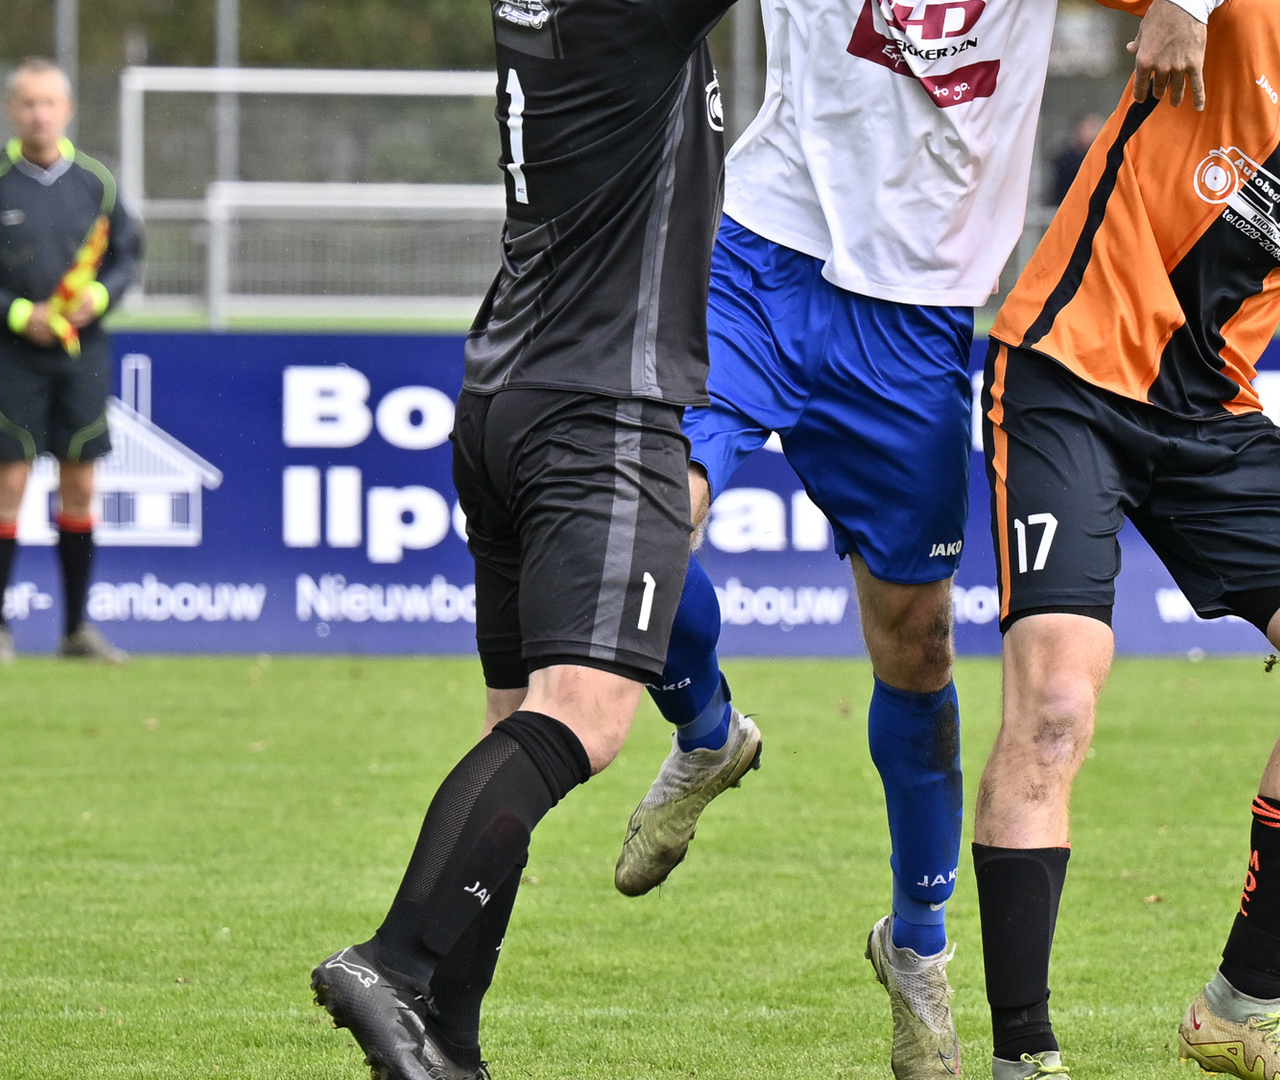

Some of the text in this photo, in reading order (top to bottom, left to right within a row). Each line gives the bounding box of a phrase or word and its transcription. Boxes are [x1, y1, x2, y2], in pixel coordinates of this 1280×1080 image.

[894, 38, 948, 61] EKKER
[933, 85, 950, 98] to
[1255, 74, 1279, 104] JAKO
[505, 68, 529, 205] 1
[929, 539, 963, 558] JAKO
[1014, 512, 1059, 574] 17
[86, 573, 267, 622] anbouw
[713, 577, 849, 626] bouw
[636, 571, 657, 632] 1
[916, 867, 959, 888] JAK
